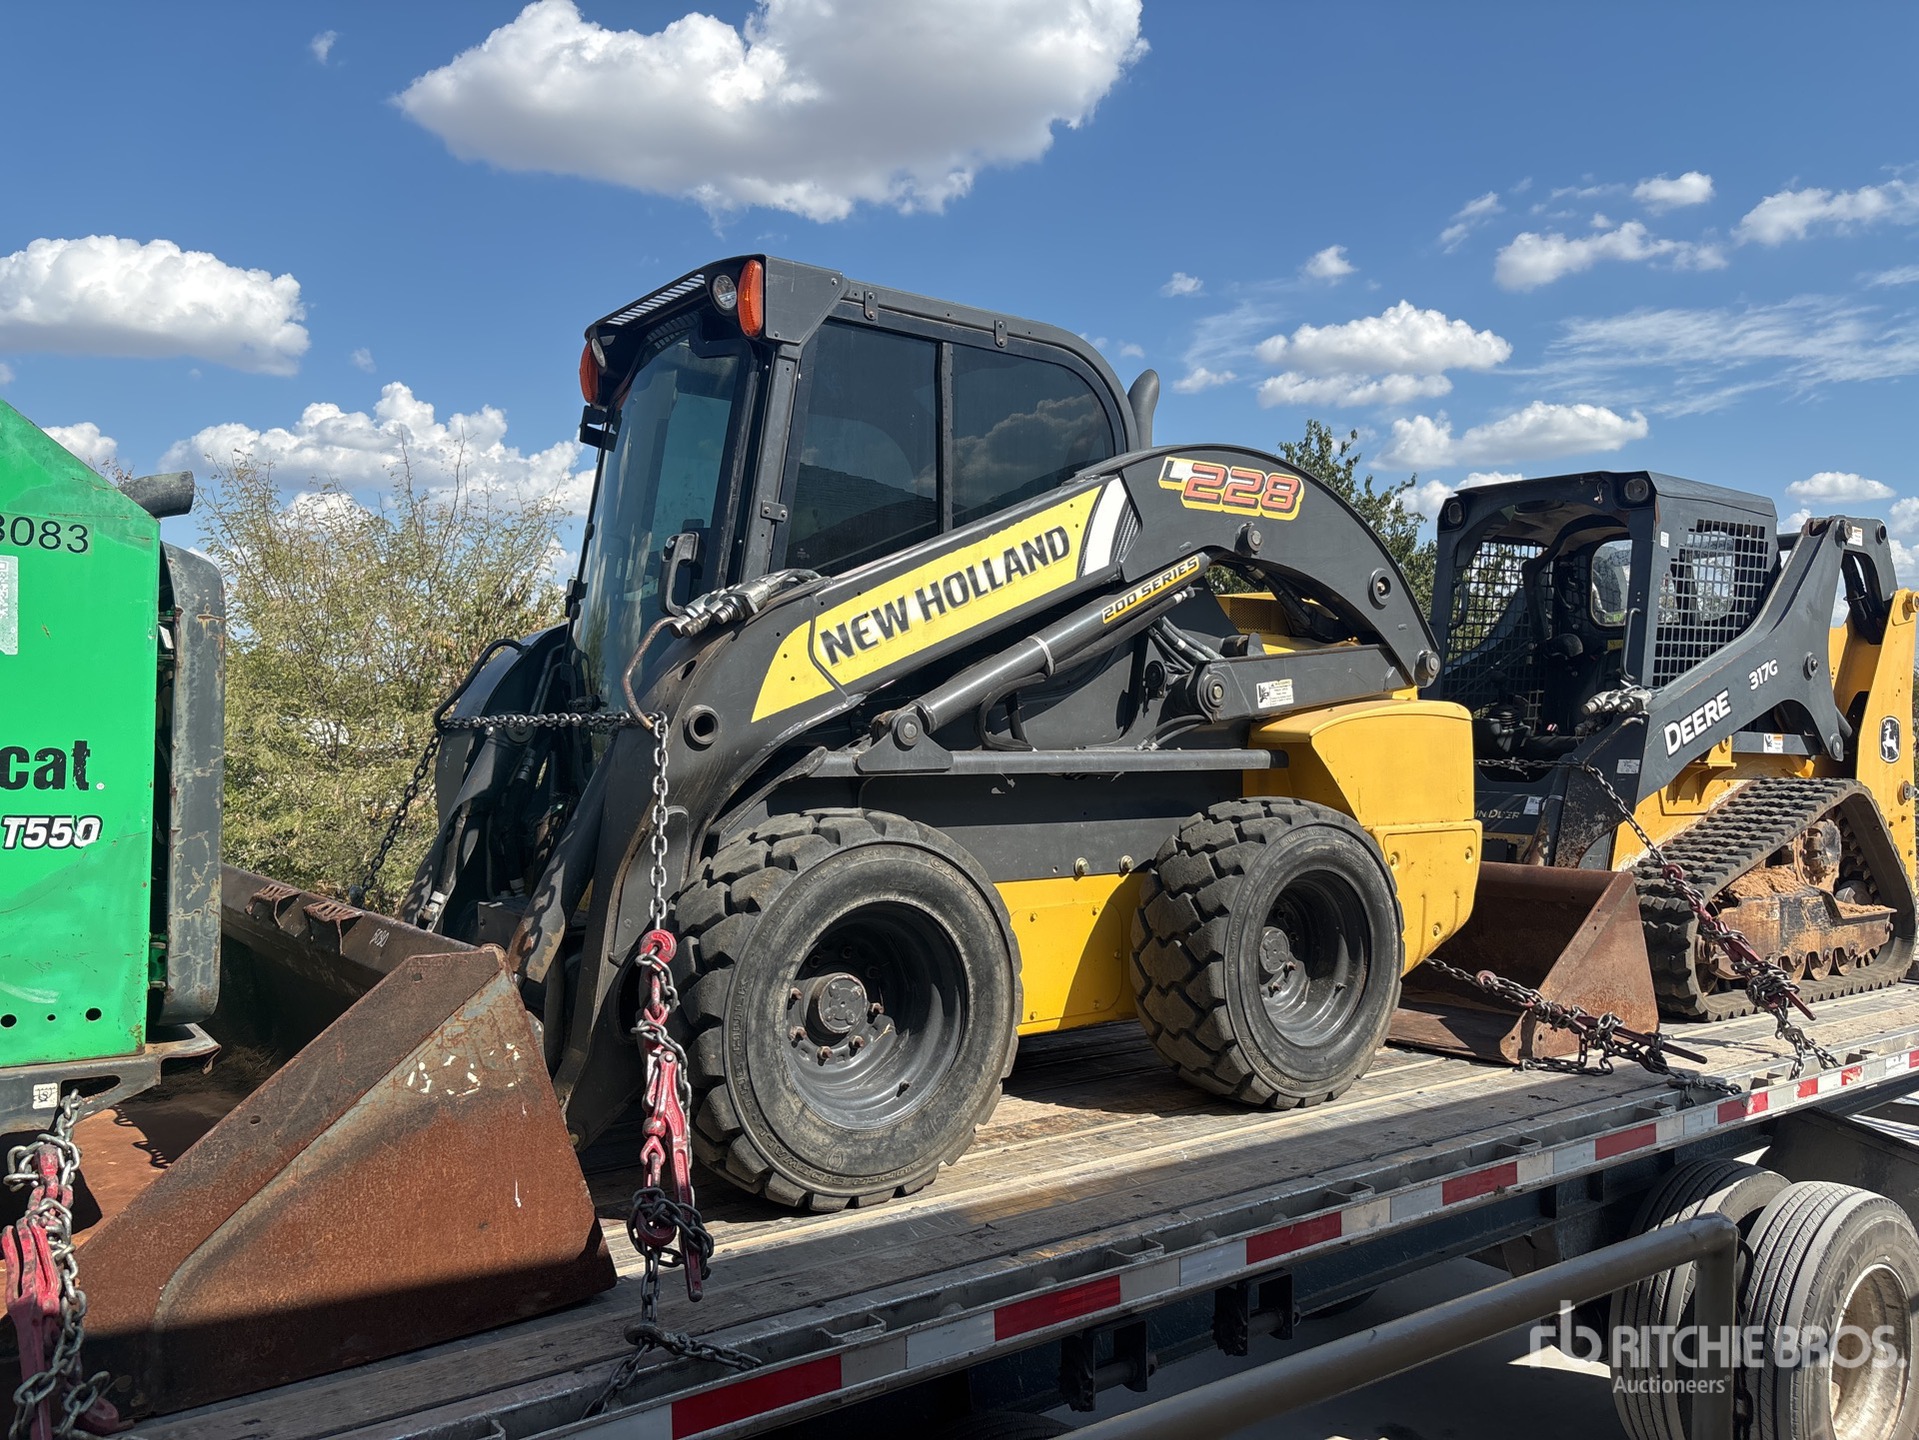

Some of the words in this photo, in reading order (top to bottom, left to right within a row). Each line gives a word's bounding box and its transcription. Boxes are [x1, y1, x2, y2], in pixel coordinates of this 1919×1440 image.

[1160, 458, 1303, 518] L228
[0, 513, 89, 554] 083
[819, 596, 911, 666] NEW
[914, 525, 1071, 623] HOLLAND
[1102, 592, 1138, 620] 200
[1141, 557, 1198, 599] SERIES
[1747, 658, 1779, 691] 317G
[1663, 688, 1733, 757] DEERE
[0, 740, 91, 790] cat
[1, 815, 104, 850] T550
